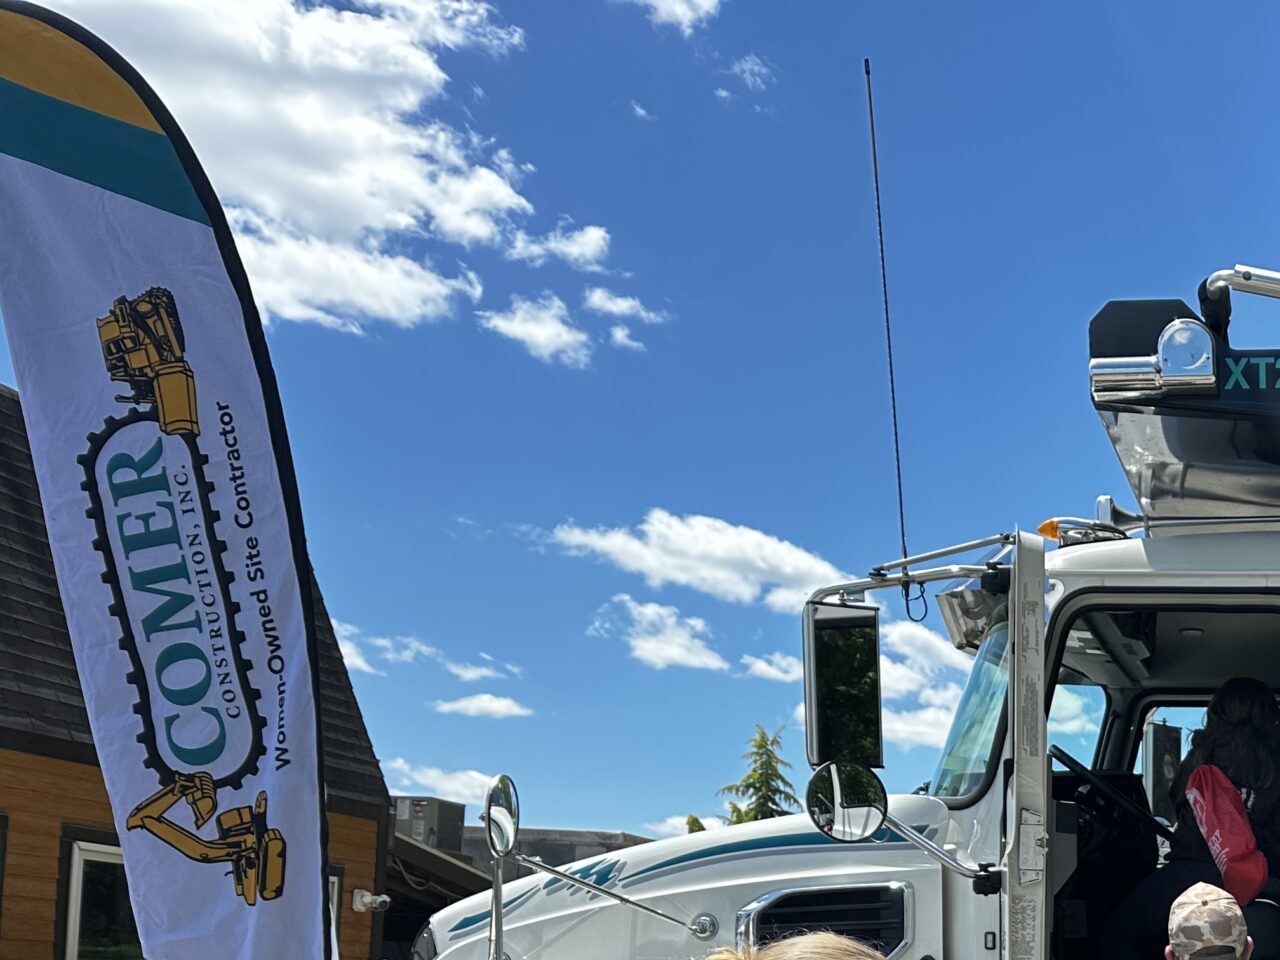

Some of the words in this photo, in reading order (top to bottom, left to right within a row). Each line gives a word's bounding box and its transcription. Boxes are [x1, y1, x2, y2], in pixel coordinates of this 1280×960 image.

[173, 464, 195, 516] INC.
[216, 401, 254, 529] Contractor
[106, 436, 227, 766] COMER
[186, 523, 241, 719] CONSTRUCTION,
[245, 536, 265, 582] Site
[248, 588, 291, 771] Women-Owned
